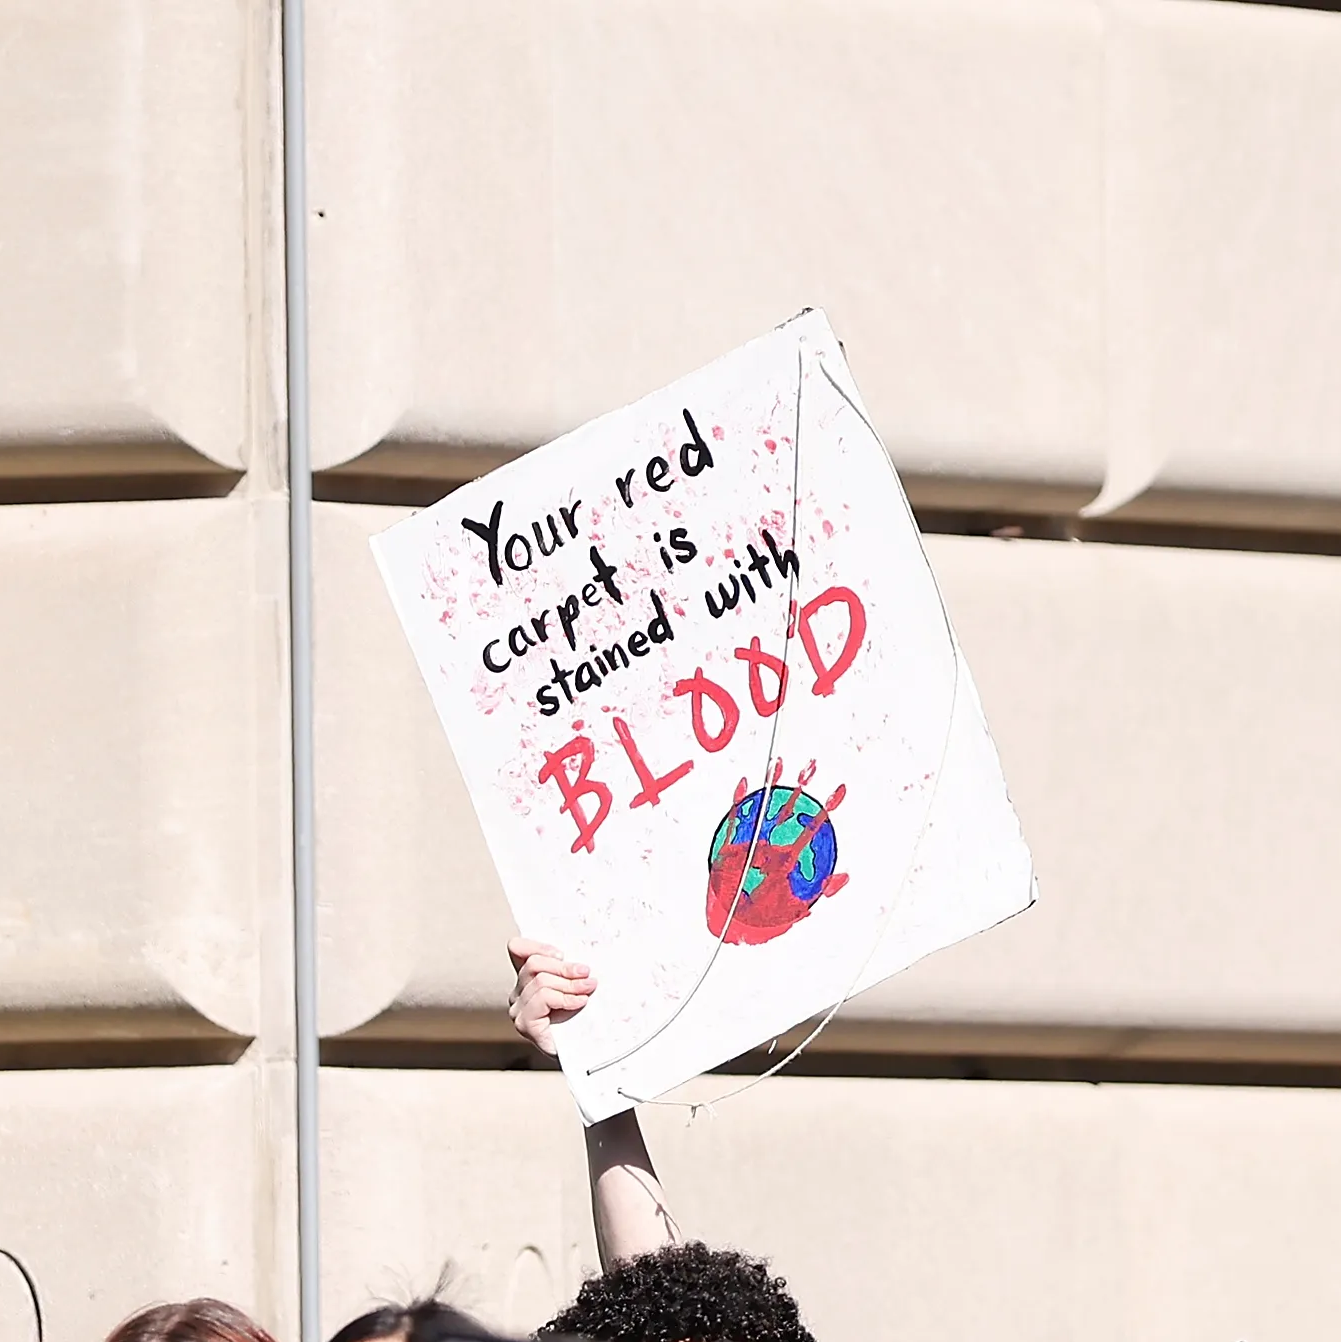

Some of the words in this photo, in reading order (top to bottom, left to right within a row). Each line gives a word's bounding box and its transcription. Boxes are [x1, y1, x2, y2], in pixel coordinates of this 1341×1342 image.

[462, 499, 582, 586] Your
[616, 408, 714, 509] red
[482, 546, 624, 674] carpet
[653, 527, 698, 575] is
[535, 588, 675, 717] stained
[705, 529, 801, 619] with
[539, 586, 867, 853] BLOOD
